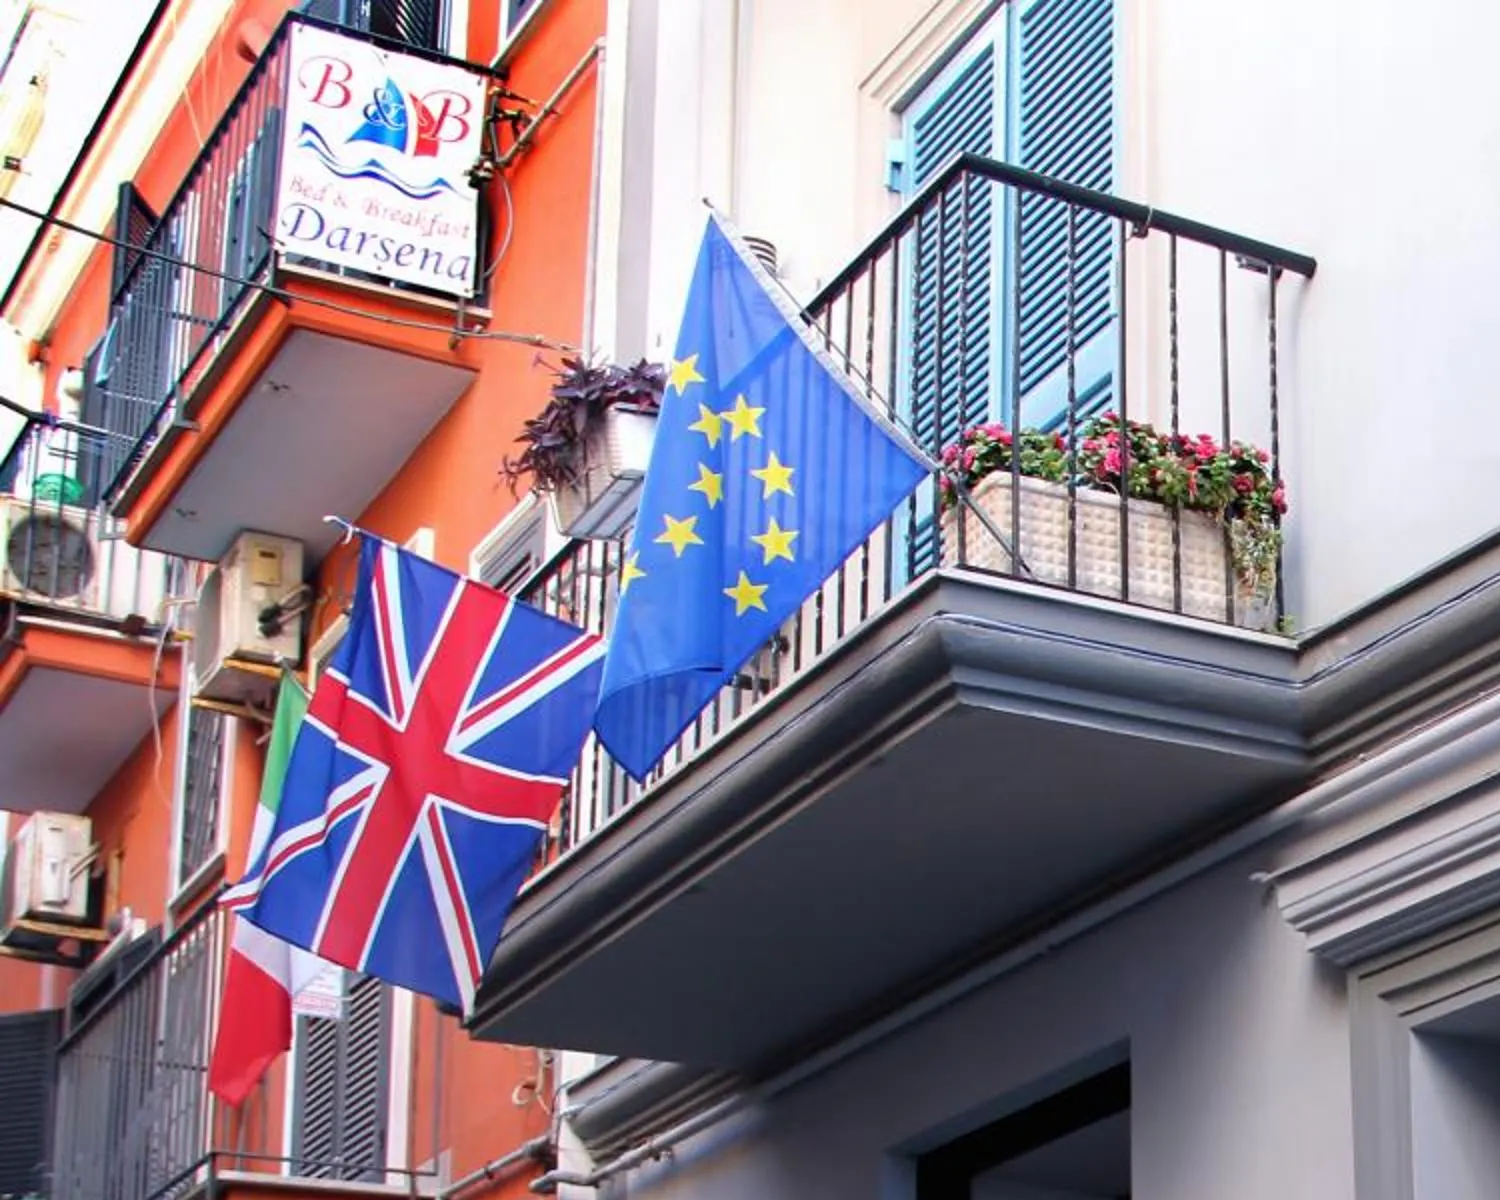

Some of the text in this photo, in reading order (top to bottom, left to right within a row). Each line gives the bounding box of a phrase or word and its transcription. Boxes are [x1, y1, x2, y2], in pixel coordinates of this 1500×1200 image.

[297, 55, 472, 143] B & B
[280, 202, 472, 281] Darsena
[289, 175, 471, 239] Bed & Breakfast
